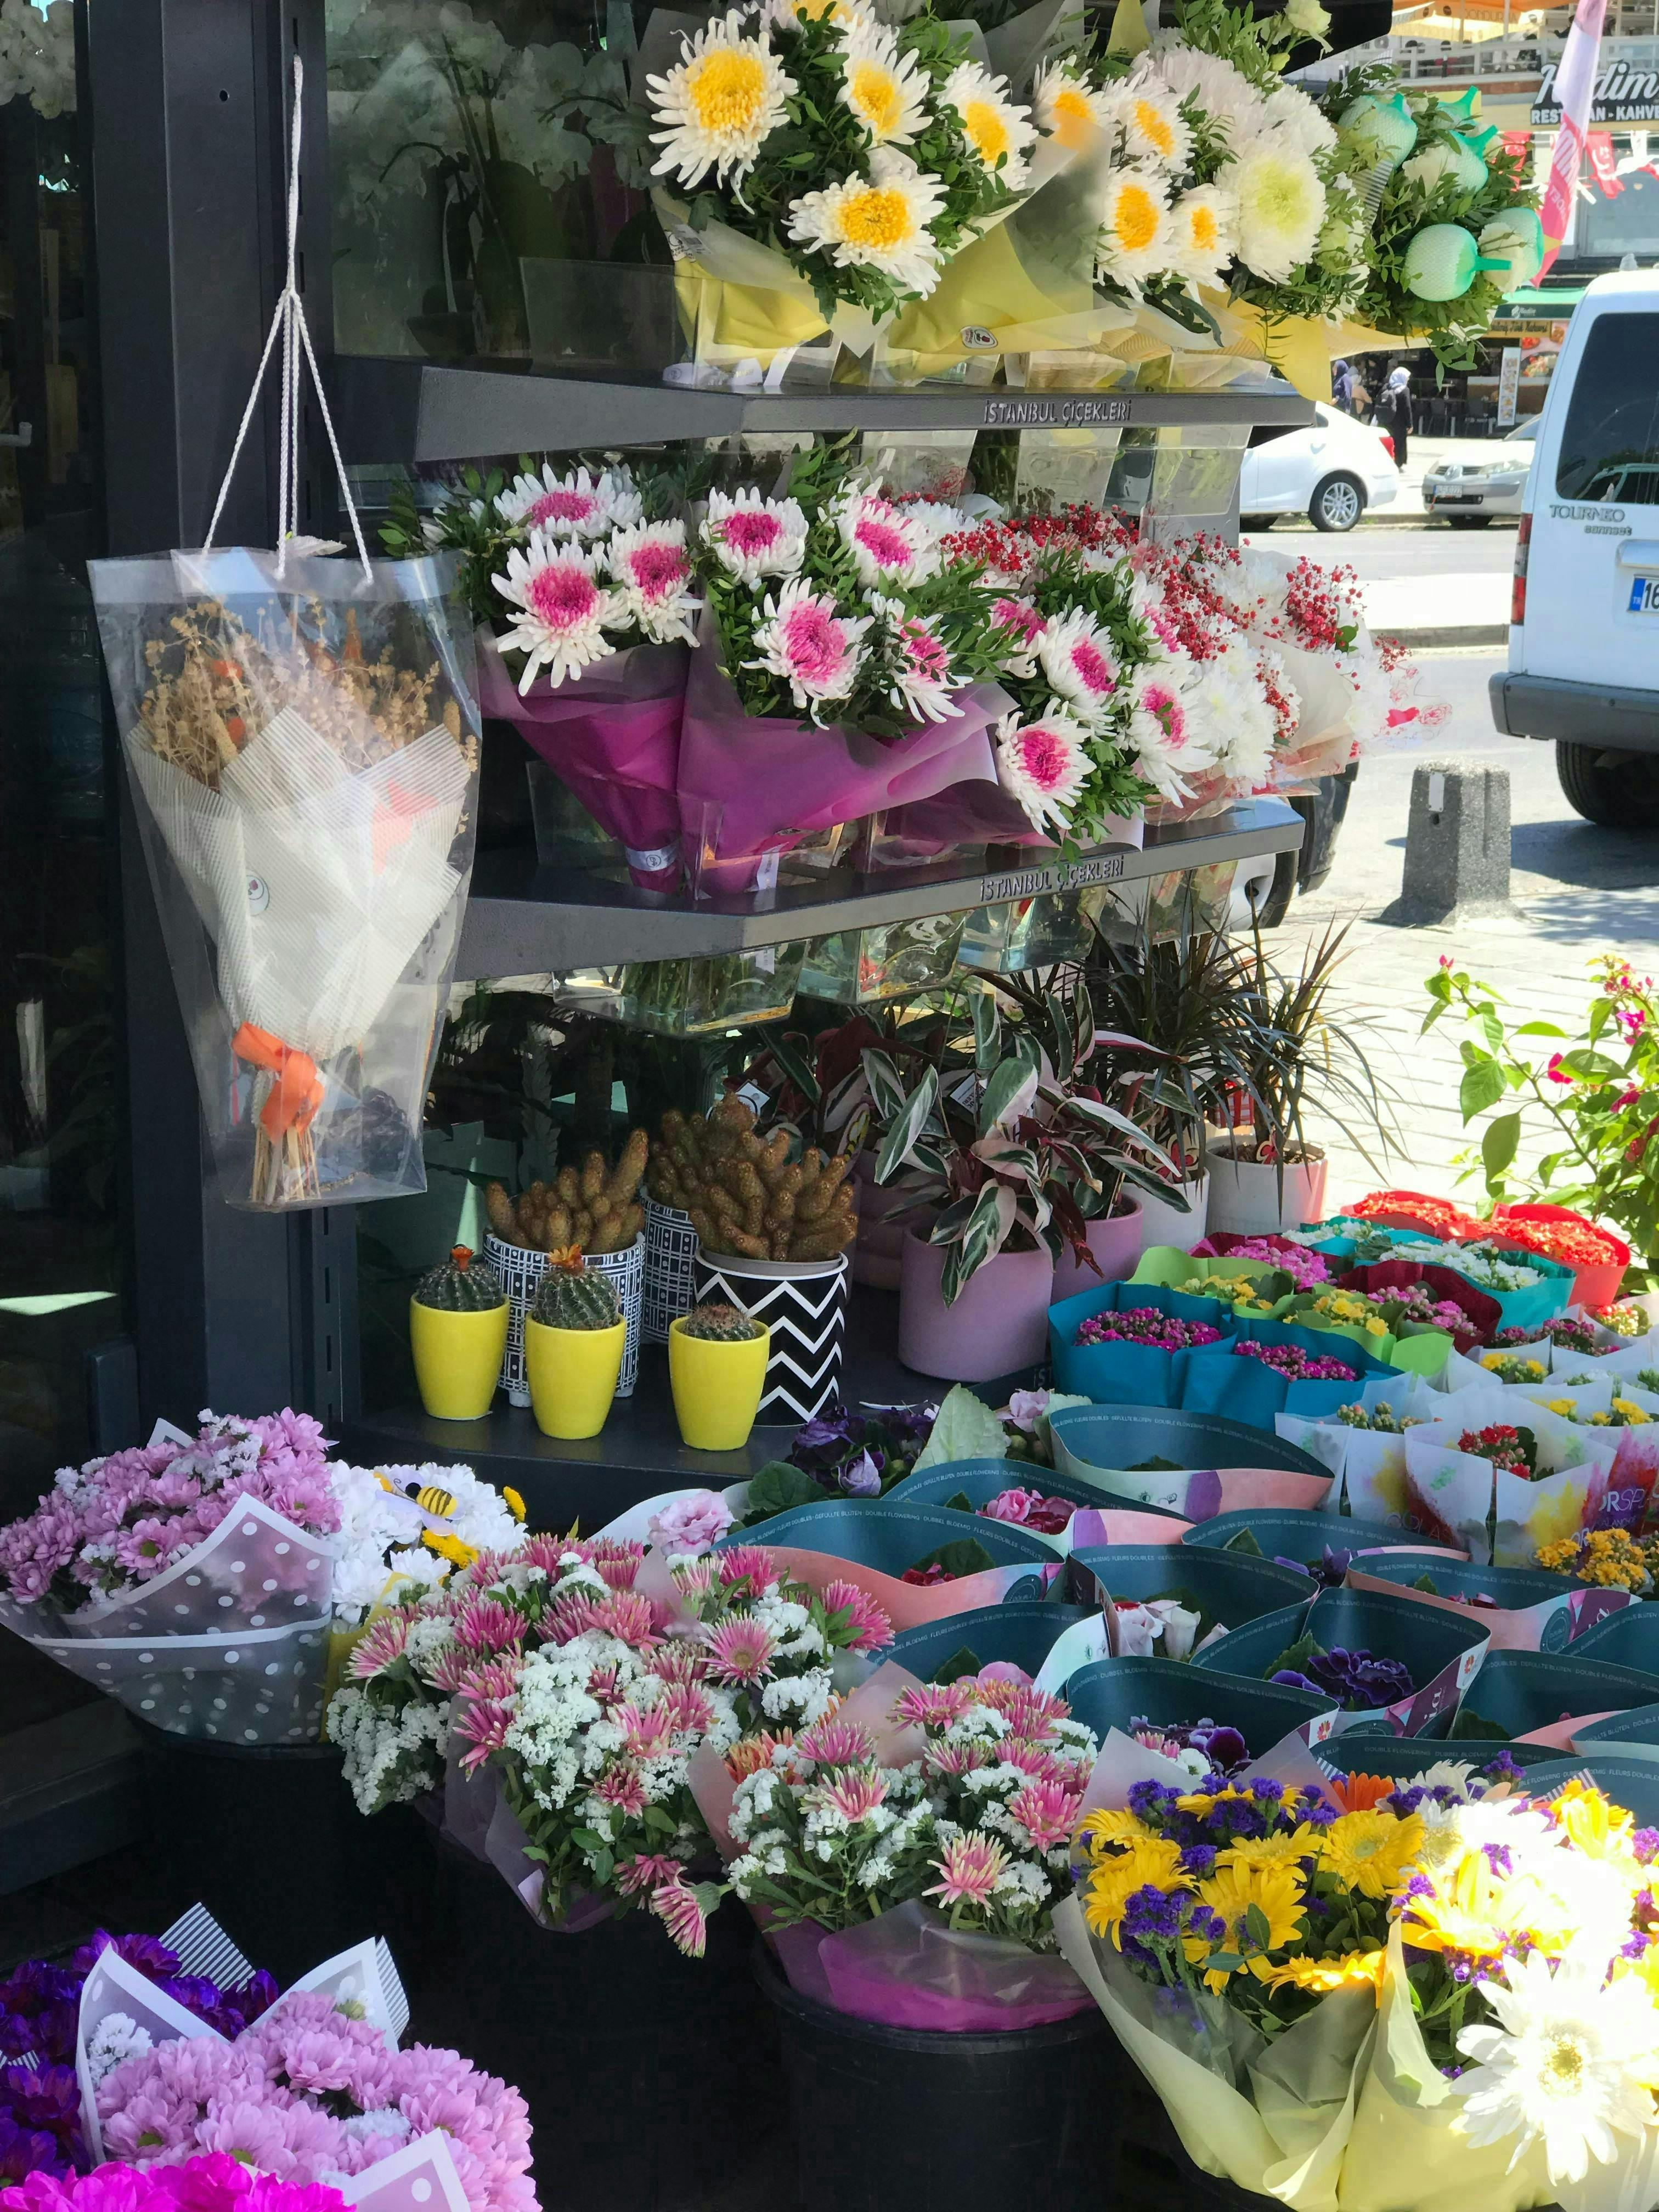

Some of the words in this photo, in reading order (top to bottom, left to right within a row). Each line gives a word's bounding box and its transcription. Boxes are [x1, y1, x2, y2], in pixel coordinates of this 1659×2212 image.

[984, 399, 1058, 424] İSTANBUL
[1062, 399, 1132, 427] ÇİÇEKLERİ
[1549, 505, 1625, 522] TOURNEO
[980, 871, 1052, 901] İSTANBUL
[1633, 1716, 1656, 1727] DOUBLE
